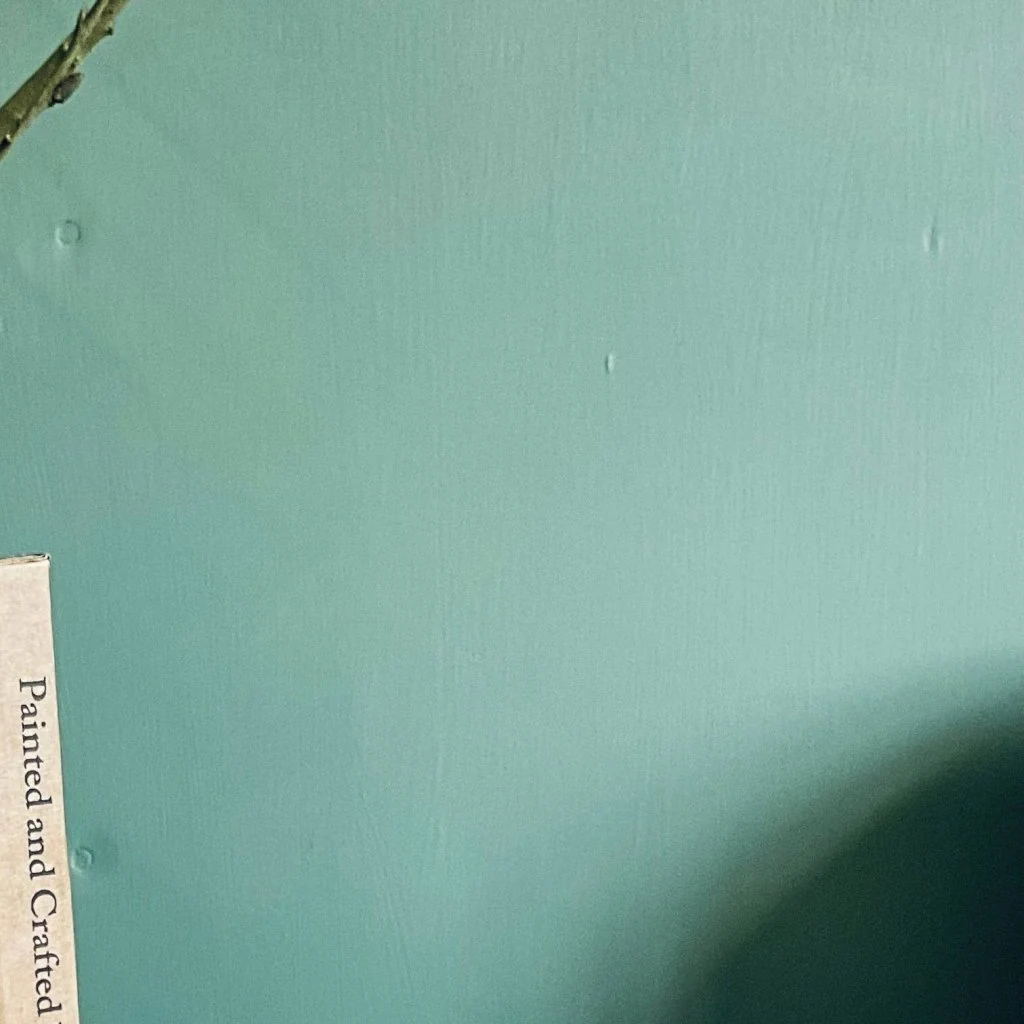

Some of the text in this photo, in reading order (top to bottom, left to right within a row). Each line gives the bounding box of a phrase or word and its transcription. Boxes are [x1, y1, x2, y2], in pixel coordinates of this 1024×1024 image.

[19, 676, 53, 810] Painted
[26, 818, 56, 881] and
[30, 888, 63, 1017] Crafted
